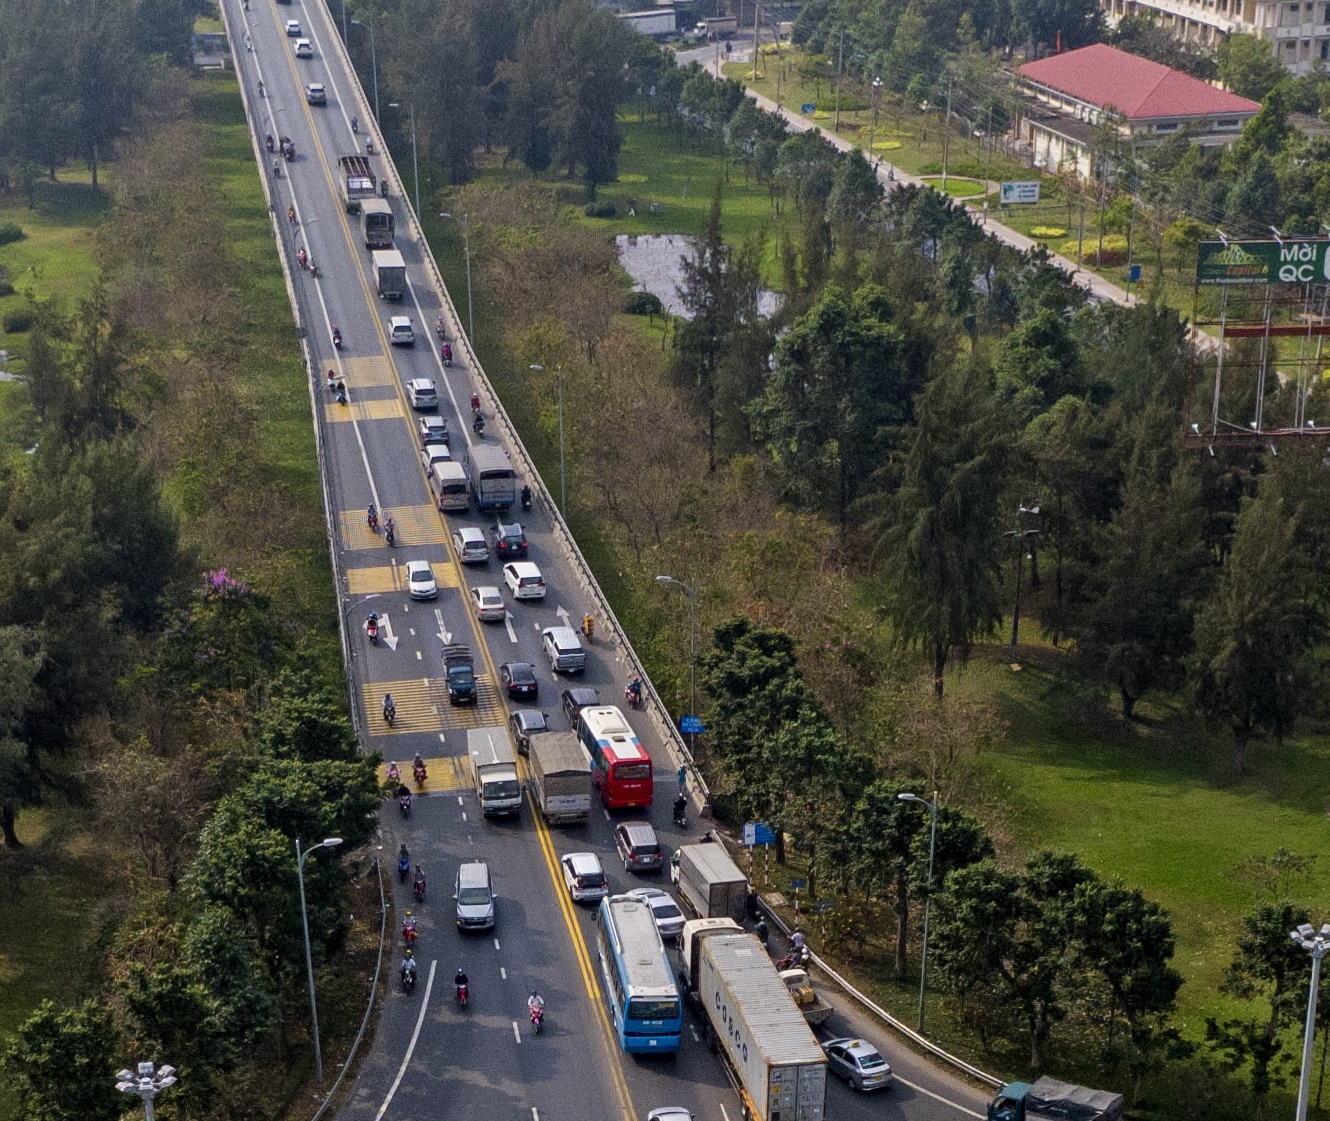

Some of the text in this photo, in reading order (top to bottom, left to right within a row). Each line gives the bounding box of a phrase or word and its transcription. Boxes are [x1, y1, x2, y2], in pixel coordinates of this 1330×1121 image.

[1280, 243, 1318, 262] Mời
[1278, 264, 1315, 282] QC
[715, 991, 748, 1063] COSCO
